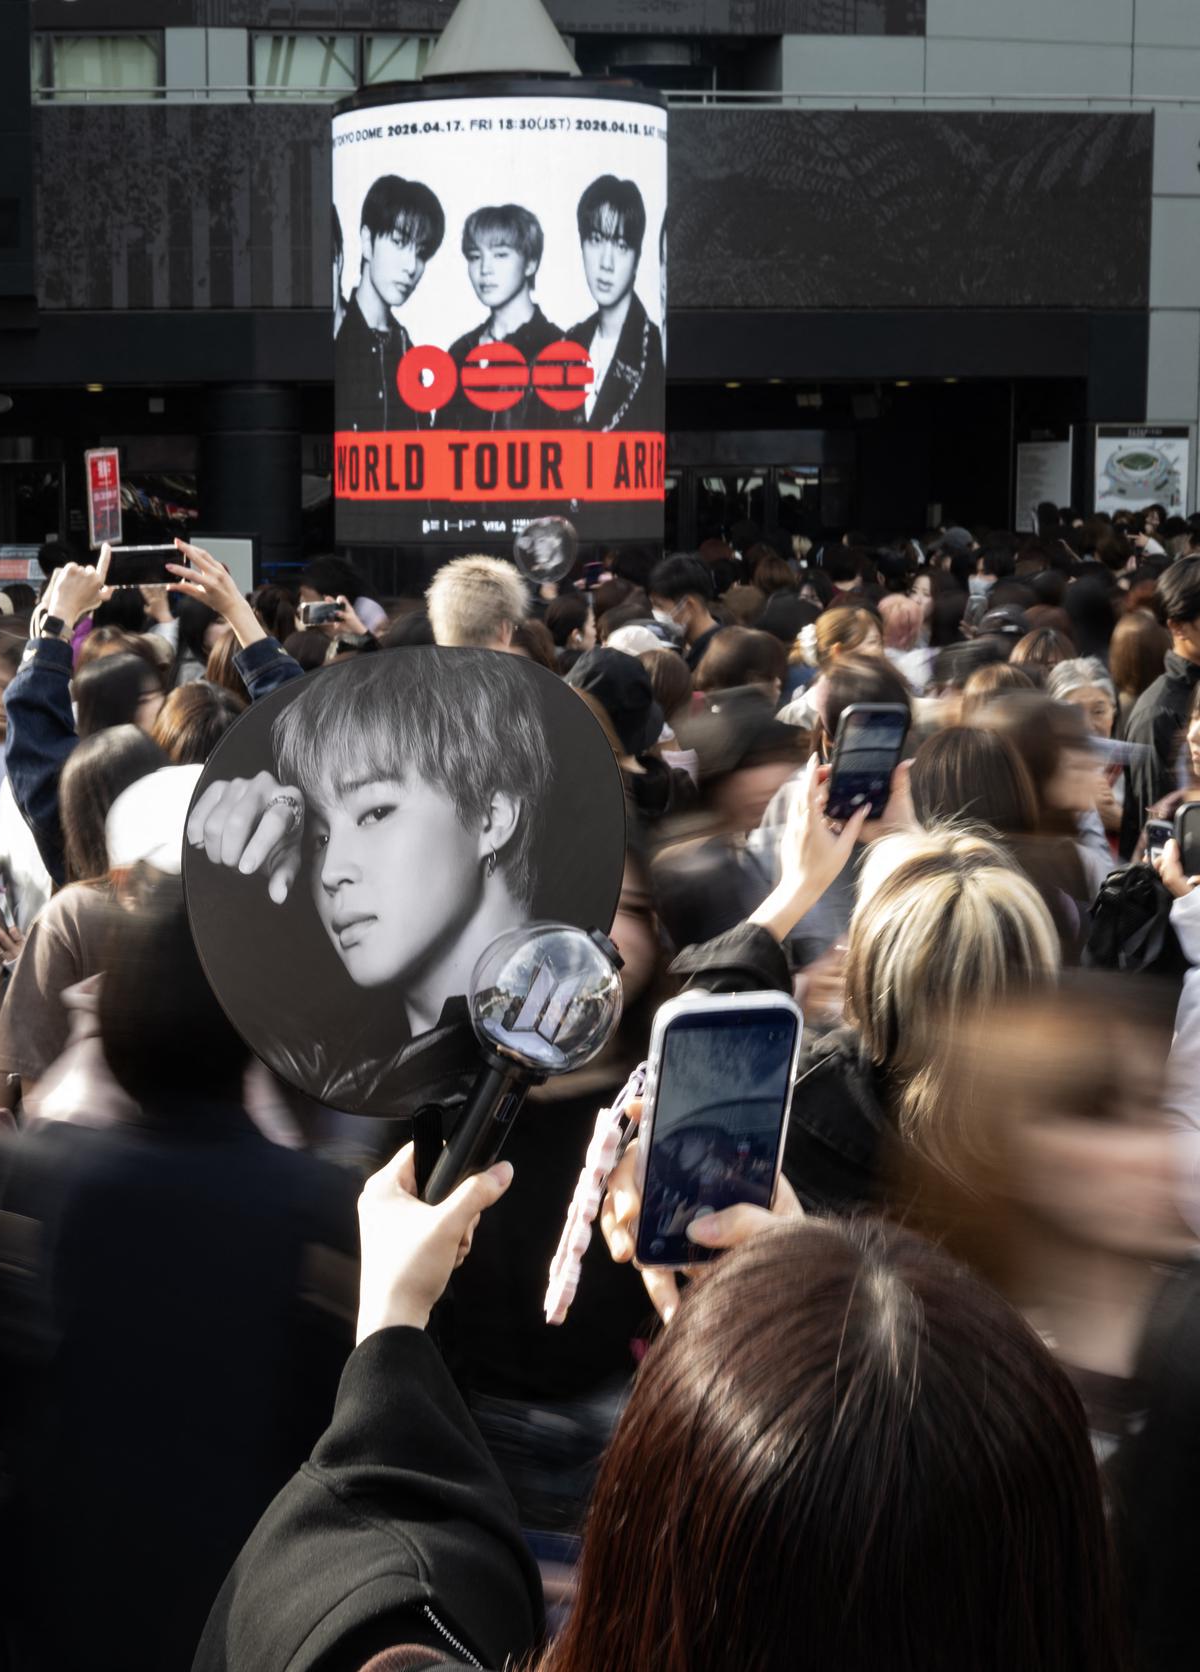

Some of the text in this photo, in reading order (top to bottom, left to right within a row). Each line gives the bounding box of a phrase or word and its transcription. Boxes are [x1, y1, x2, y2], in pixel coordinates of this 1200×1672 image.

[356, 127, 383, 142] DOME
[388, 120, 465, 137] 2026.04.17.
[470, 119, 492, 131] FRI
[498, 116, 571, 131] 18:30(JST)
[337, 443, 425, 492] WORLD
[448, 442, 563, 490] TOUR
